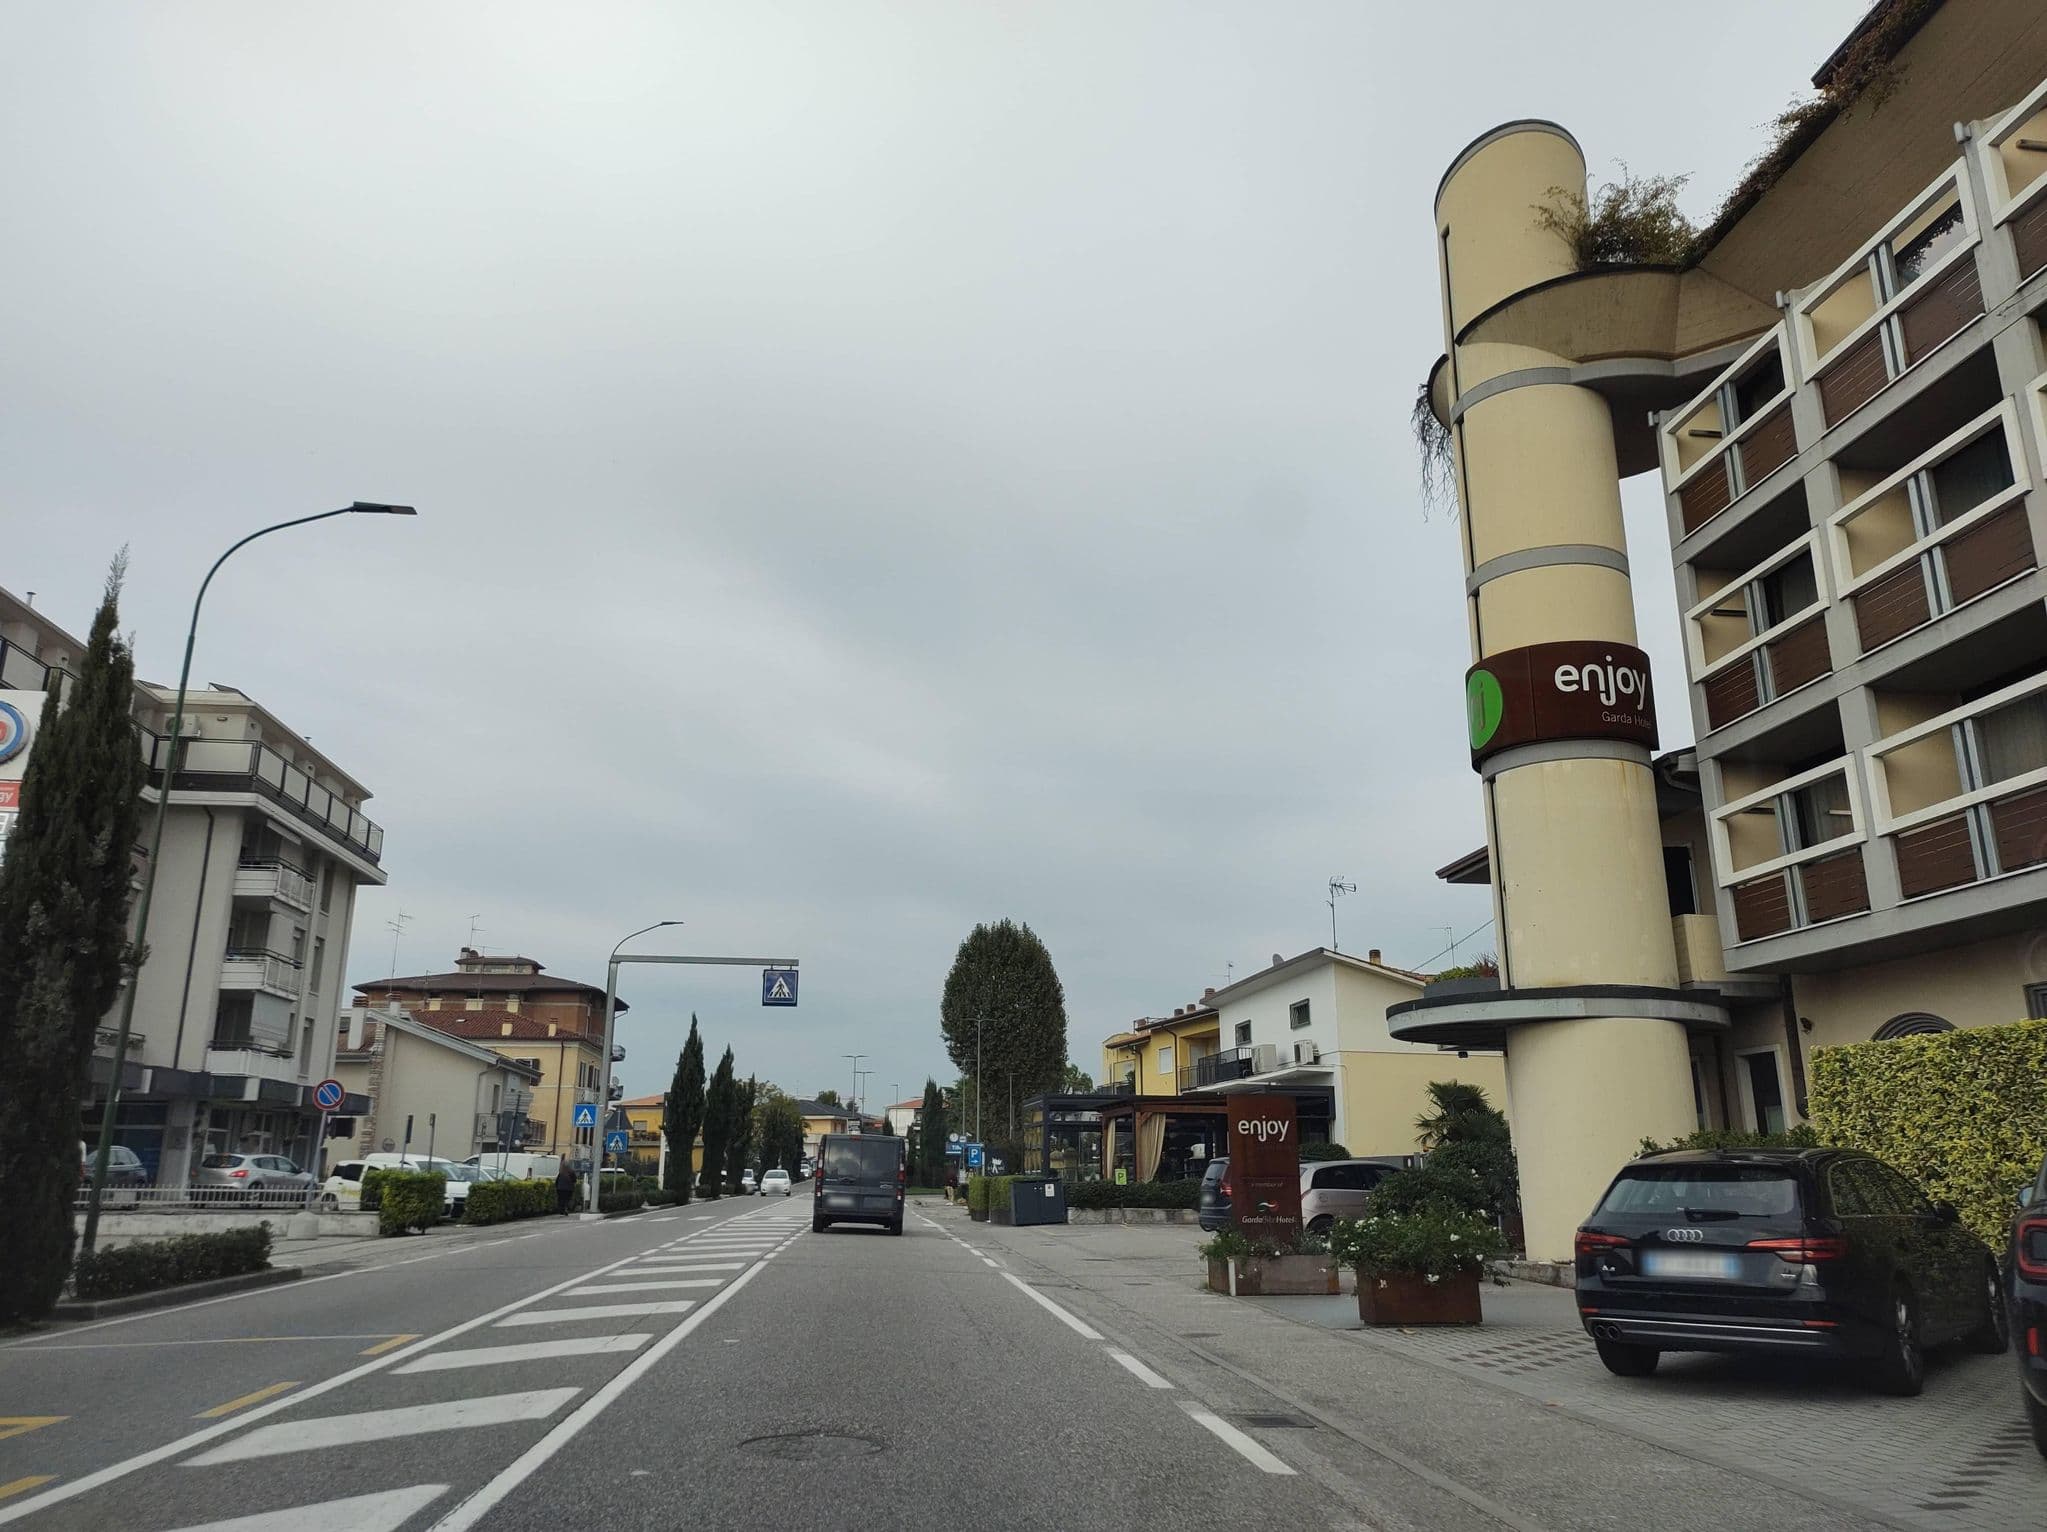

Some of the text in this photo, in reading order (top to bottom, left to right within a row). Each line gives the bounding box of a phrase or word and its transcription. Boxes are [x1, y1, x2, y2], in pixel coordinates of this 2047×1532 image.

[1554, 655, 1646, 710] enjoy
[1601, 711, 1632, 724] Garda
[1238, 1115, 1290, 1142] enjoy
[971, 1148, 979, 1158] P
